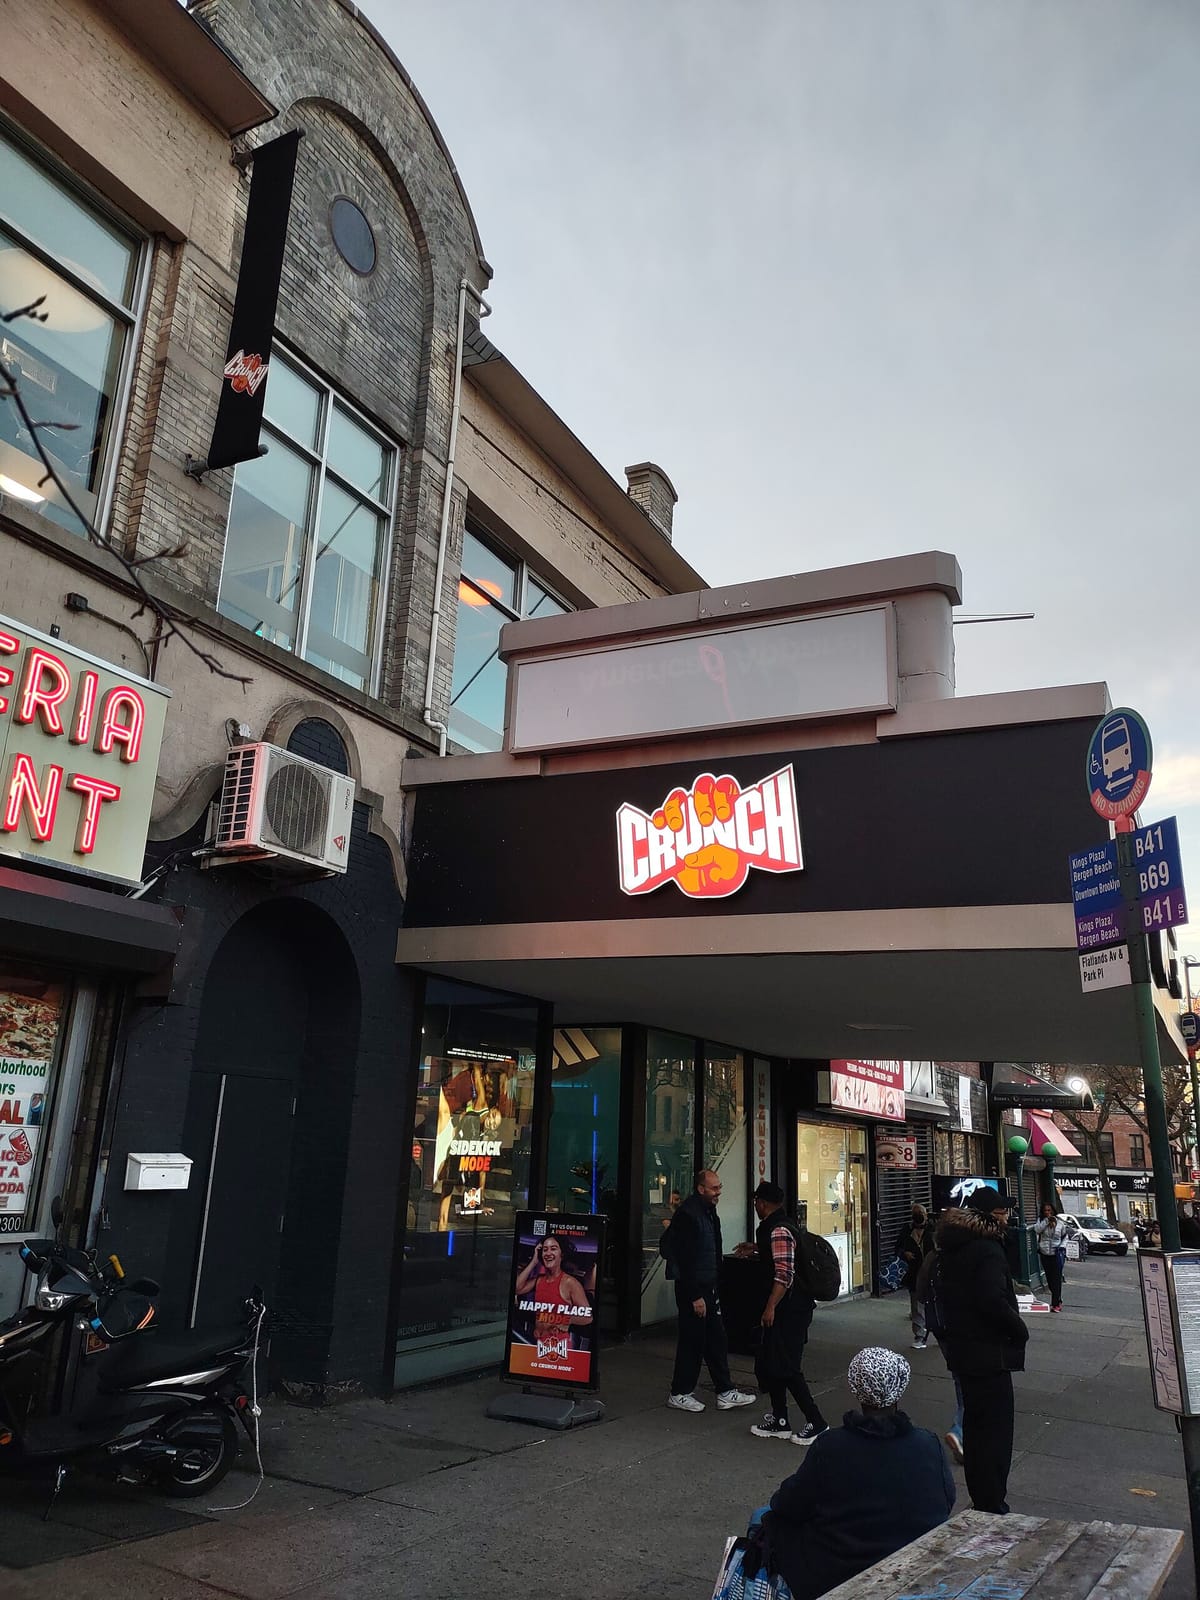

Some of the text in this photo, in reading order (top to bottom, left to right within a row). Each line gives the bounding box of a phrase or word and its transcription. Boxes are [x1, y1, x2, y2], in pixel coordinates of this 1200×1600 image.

[224, 350, 269, 396] CRUNCH
[1, 752, 121, 854] NT
[1095, 795, 1107, 811] NO
[1107, 779, 1145, 815] STANDING
[618, 765, 802, 893] CRUNCH
[1135, 825, 1163, 858] B41
[1072, 857, 1088, 870] Kings
[1073, 860, 1113, 882] Bergen Beach
[1140, 861, 1169, 893] B69
[1075, 879, 1121, 902] Downtown Brooklyn
[1143, 895, 1172, 927] B41
[1078, 921, 1094, 933] Kings
[1080, 926, 1120, 946] Bergen Beach
[1082, 949, 1124, 968] Flatlands Av &
[1083, 967, 1104, 982] Park Pl
[0, 1058, 47, 1077] borhood
[0, 1150, 30, 1161] ICES
[449, 1140, 502, 1156] SIDEKICK
[897, 1146, 914, 1161] $8
[8, 1166, 19, 1178] A
[459, 1156, 492, 1172] MODE
[0, 1216, 21, 1232] 300
[519, 1300, 593, 1317] HAPPY PLACE
[538, 1312, 570, 1325] MODE
[537, 1338, 568, 1359] CRUNCH
